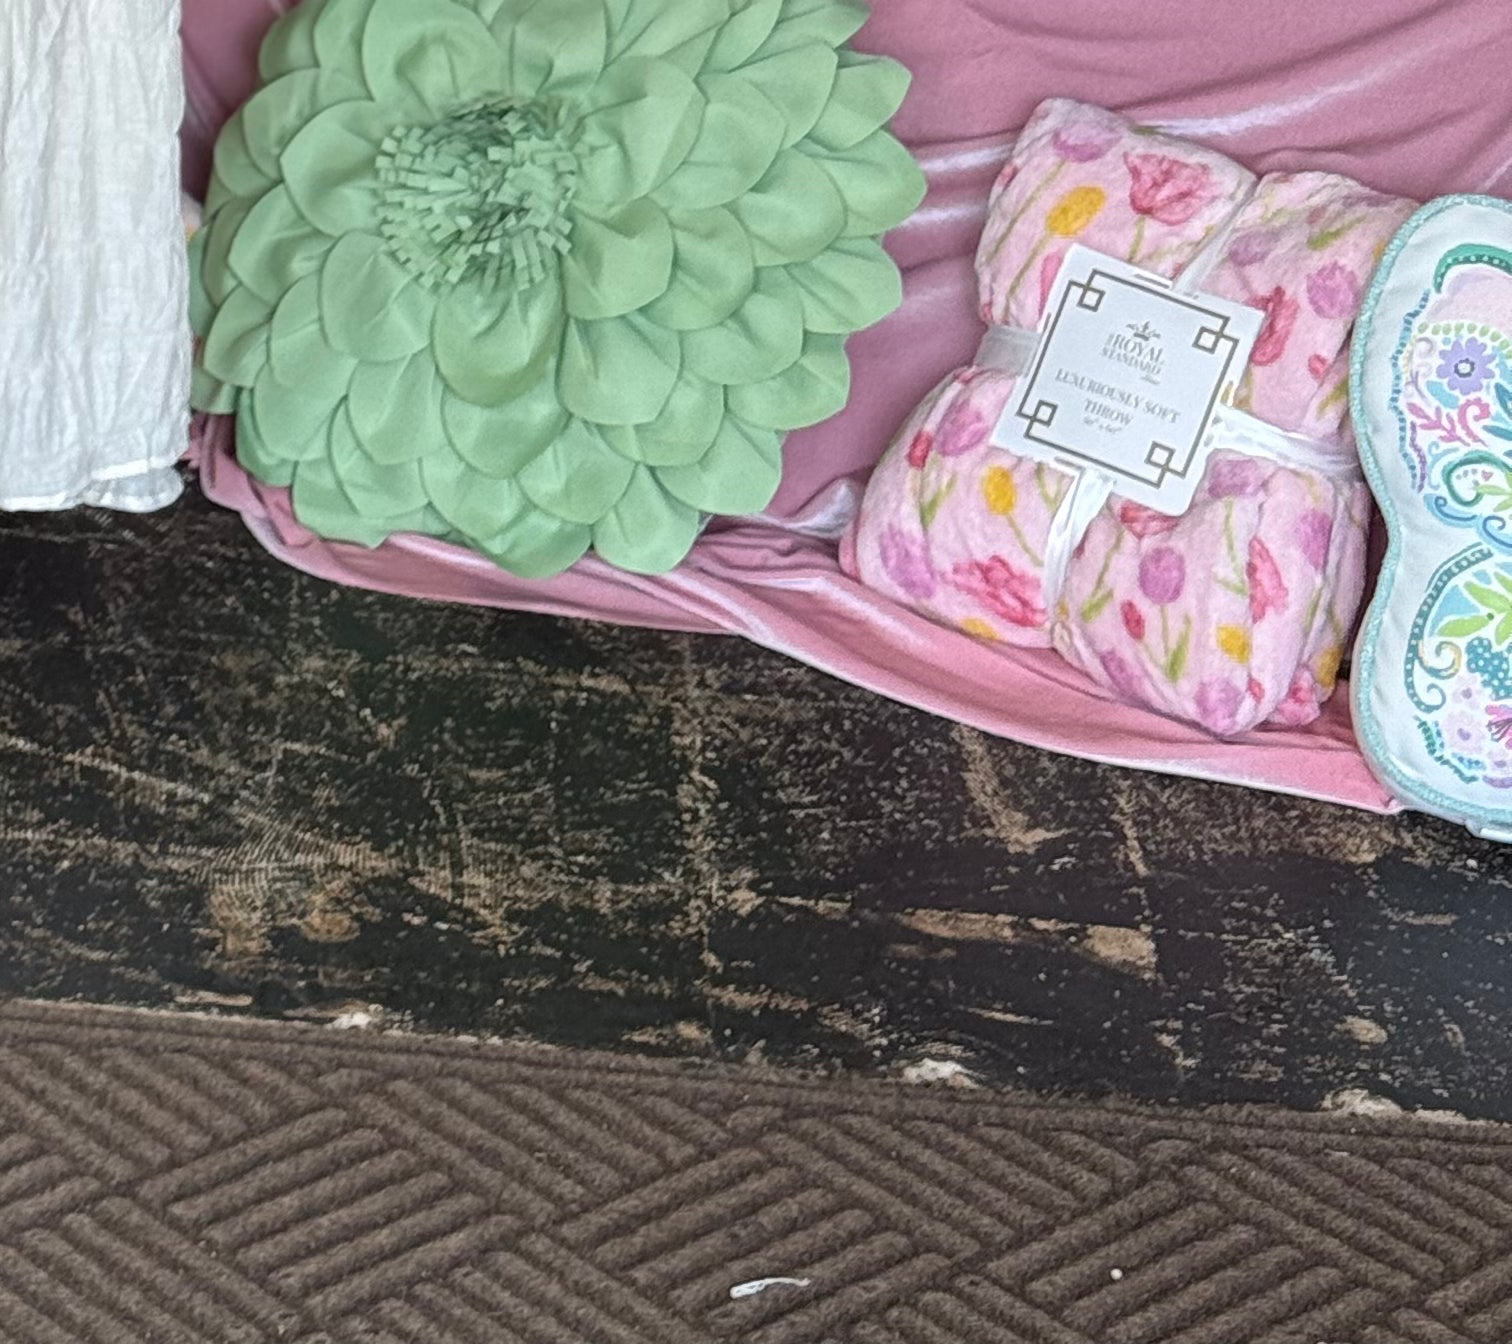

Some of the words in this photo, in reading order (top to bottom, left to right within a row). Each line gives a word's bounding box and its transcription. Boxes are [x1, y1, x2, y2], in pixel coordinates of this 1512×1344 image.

[1112, 333, 1164, 364] ROYAL
[1054, 368, 1144, 409] LUXURIOUSLY
[1143, 400, 1181, 424] SOFT
[1083, 398, 1134, 426] THROW
